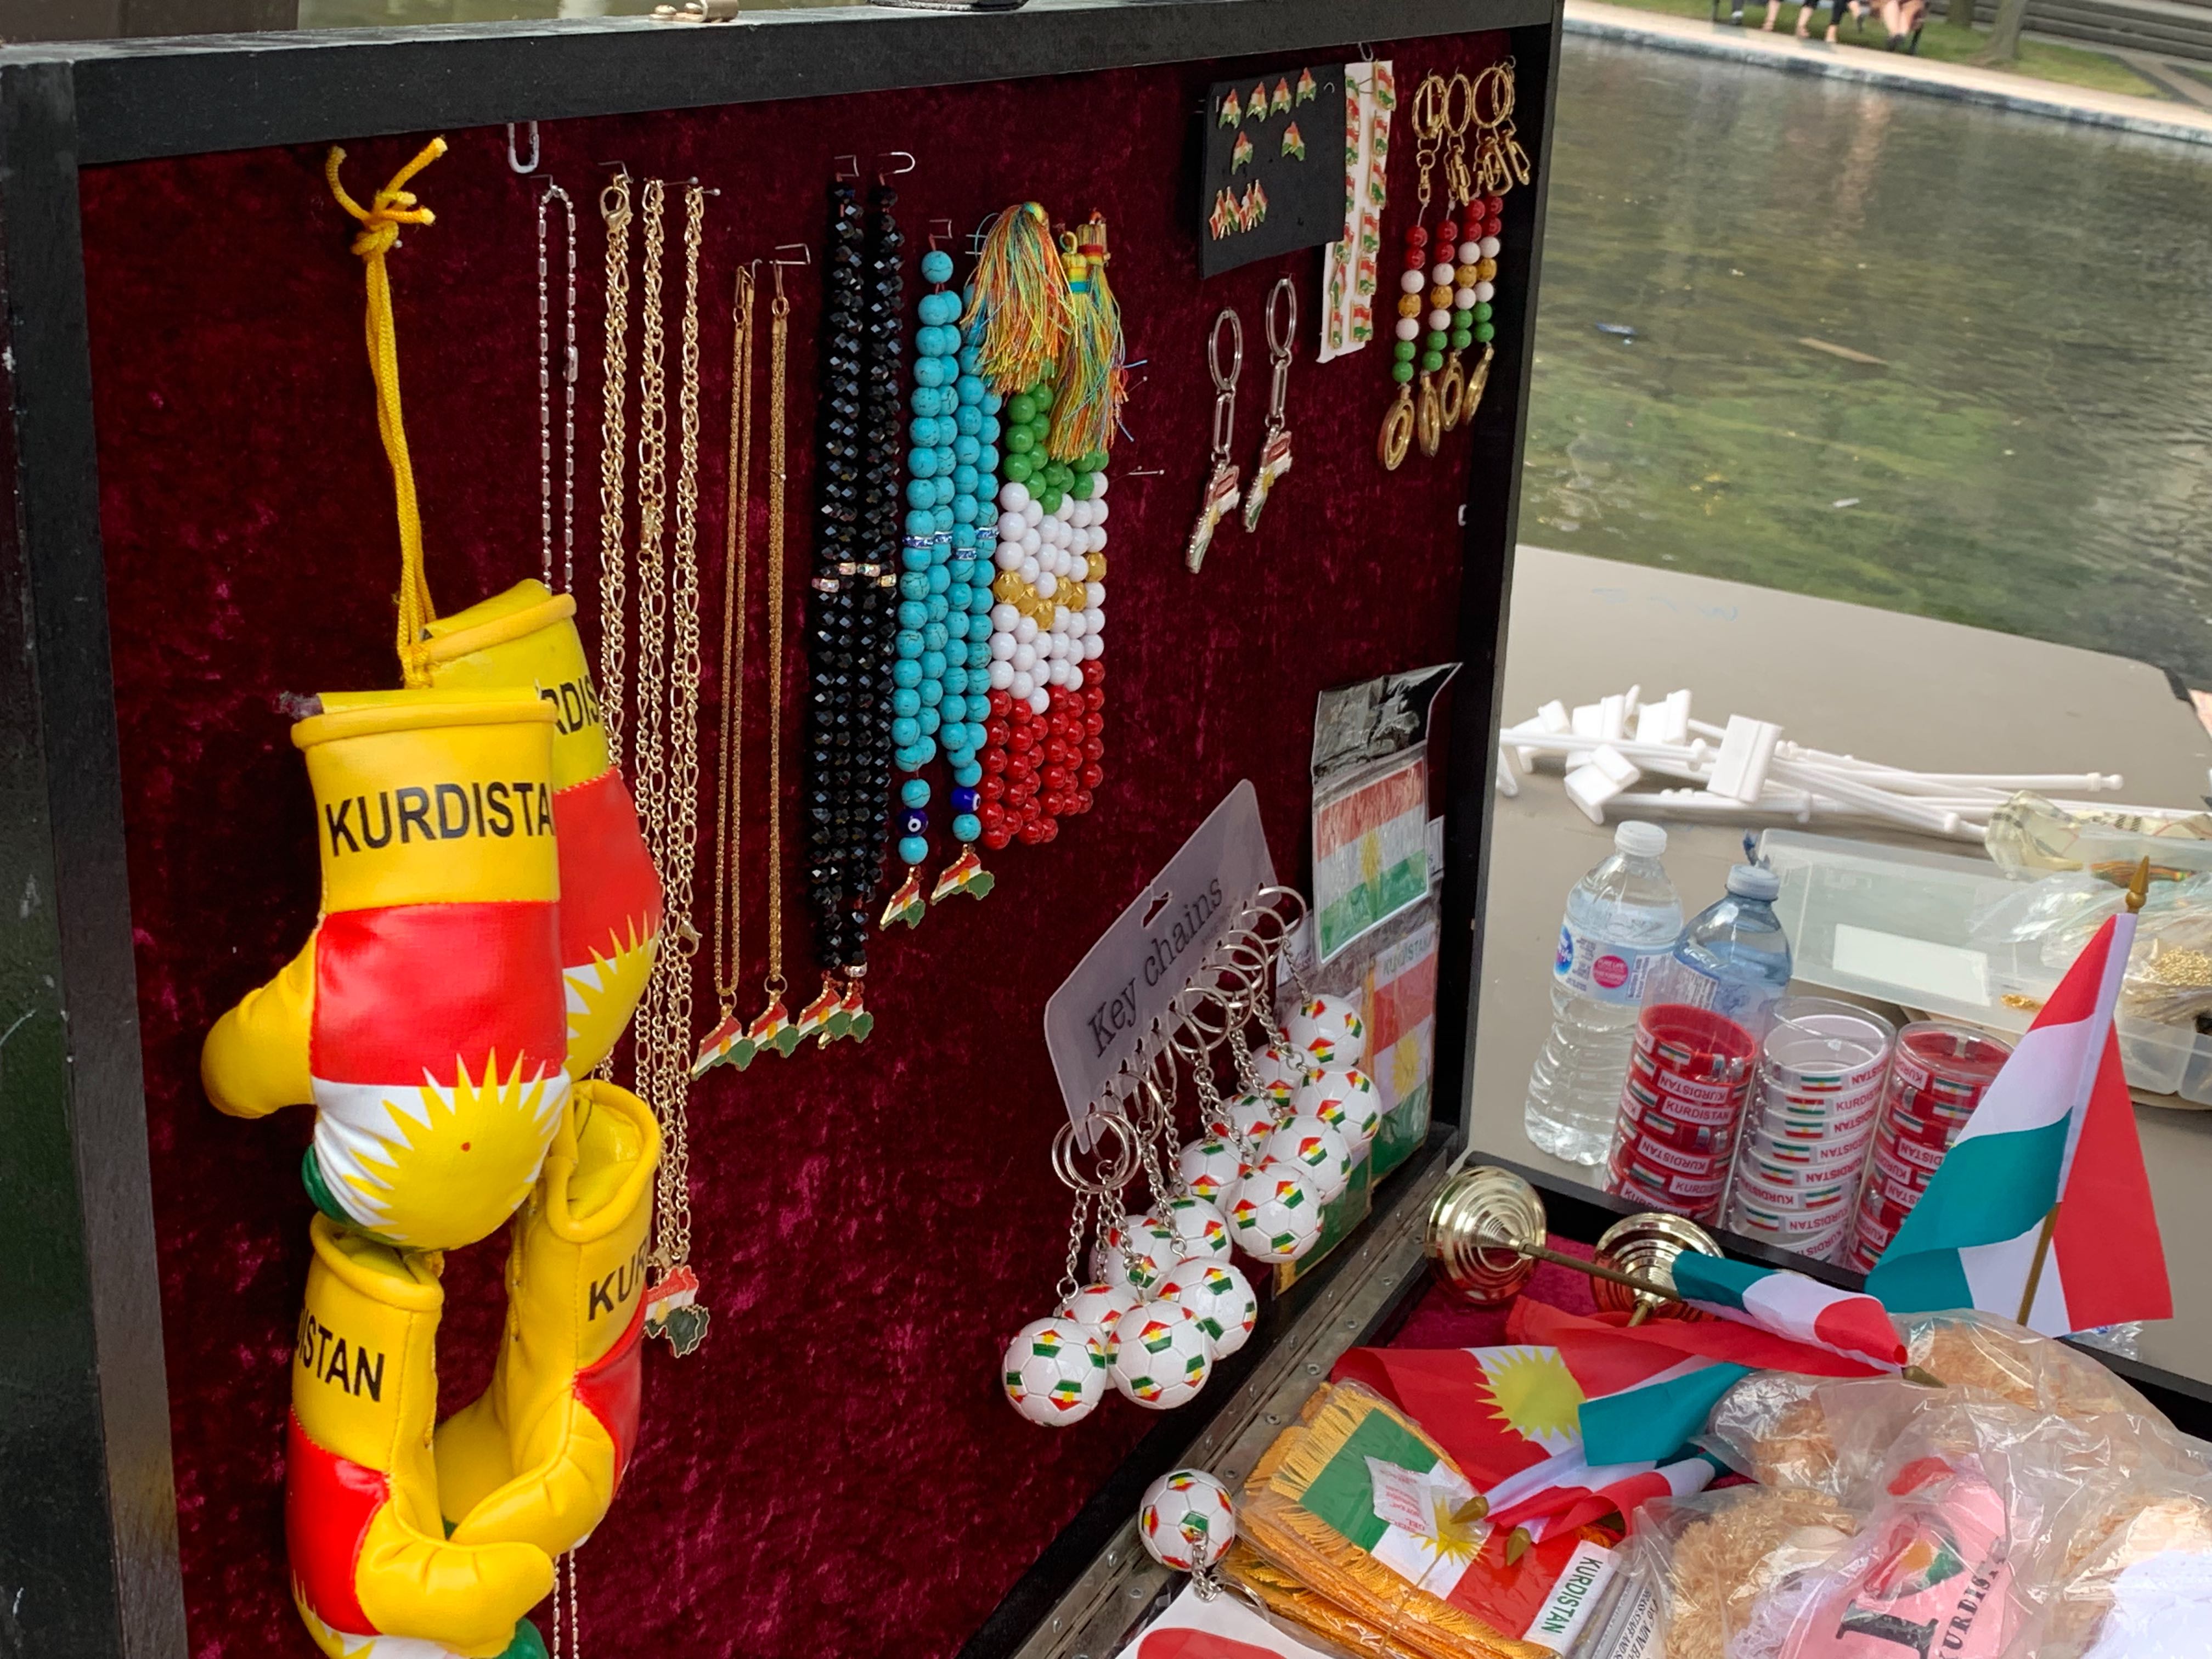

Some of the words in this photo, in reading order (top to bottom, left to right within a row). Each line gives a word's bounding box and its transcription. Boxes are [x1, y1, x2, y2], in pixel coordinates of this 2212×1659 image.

[1088, 978, 1136, 1058] Key
[1145, 879, 1222, 987] chains
[1660, 1073, 1726, 1102] KURDISTAN
[1666, 1100, 1729, 1120] KURDISTAN
[1641, 1141, 1706, 1171] KURDISTAN
[1541, 1556, 1604, 1634] KURDISTAN
